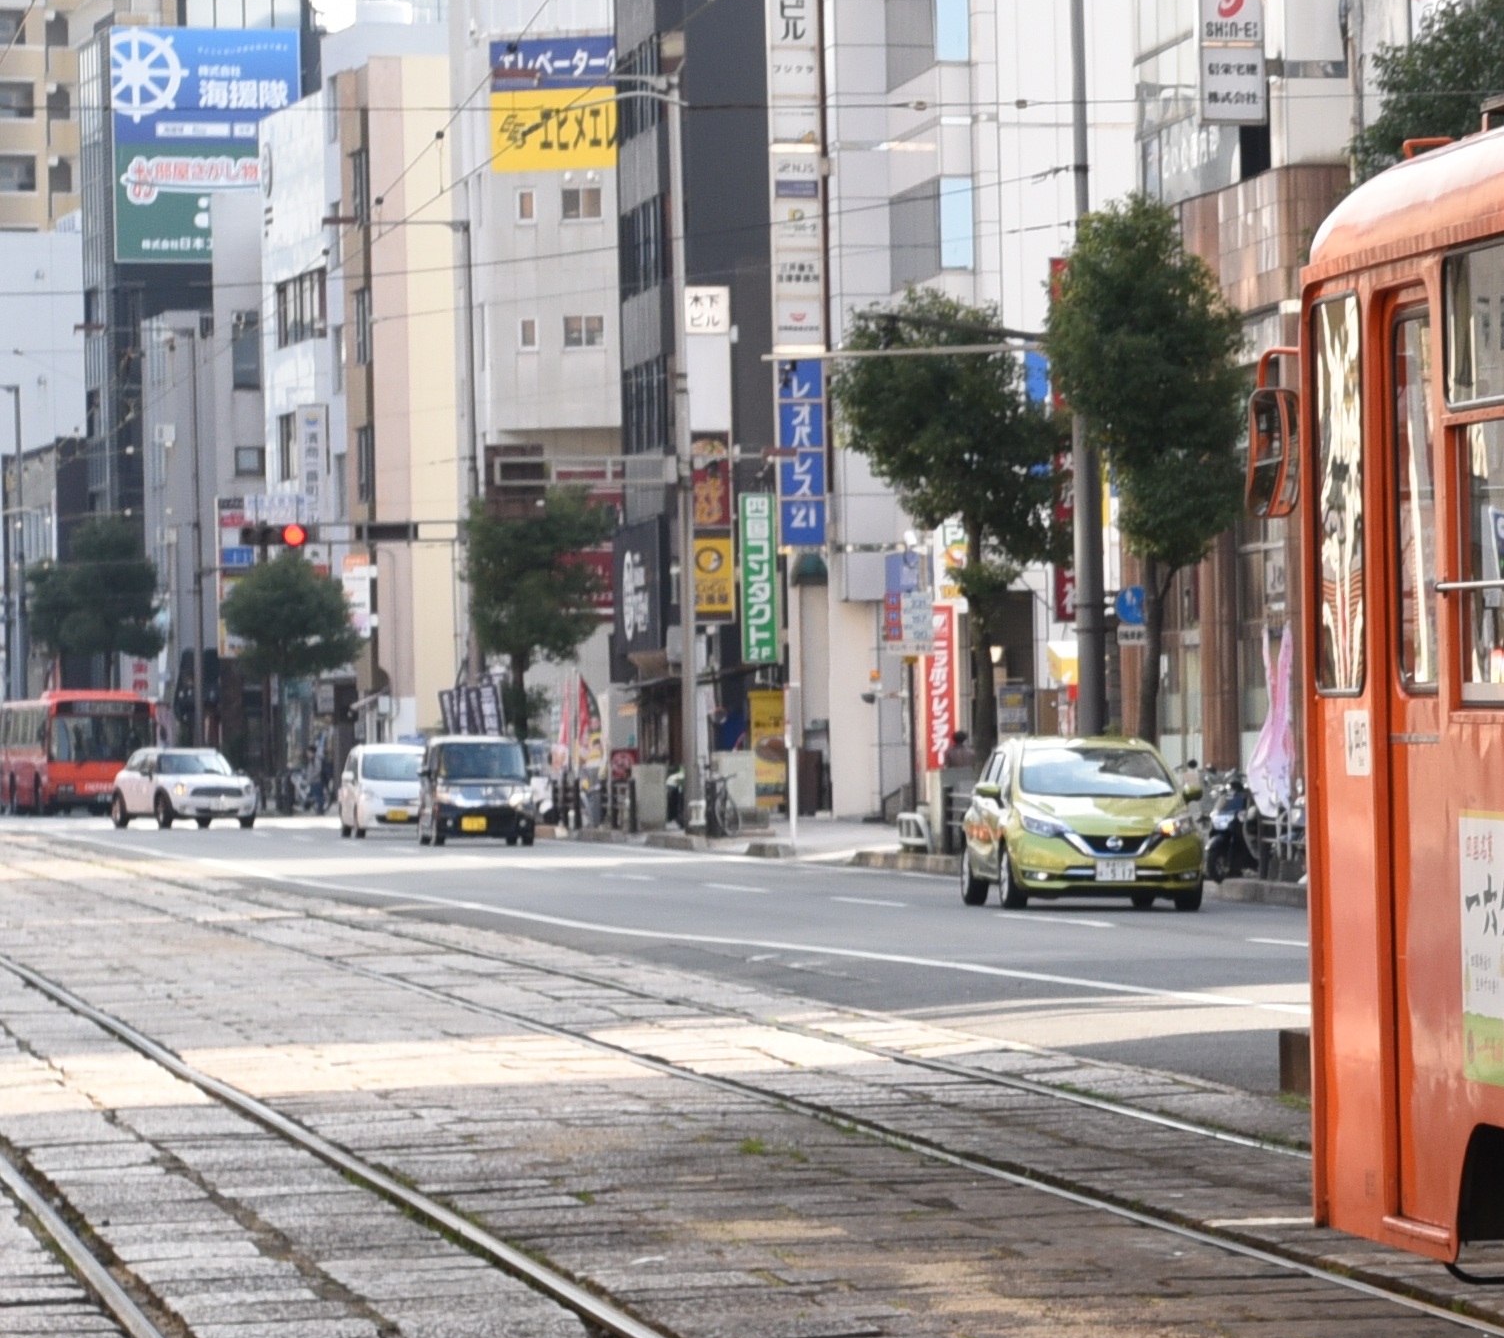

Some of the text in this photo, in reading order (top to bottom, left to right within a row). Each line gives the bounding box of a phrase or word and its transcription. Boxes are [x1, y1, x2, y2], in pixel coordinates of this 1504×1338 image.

[199, 79, 288, 110] 海援隊
[689, 313, 721, 328] ビル
[746, 495, 771, 645] 四国コンタクト
